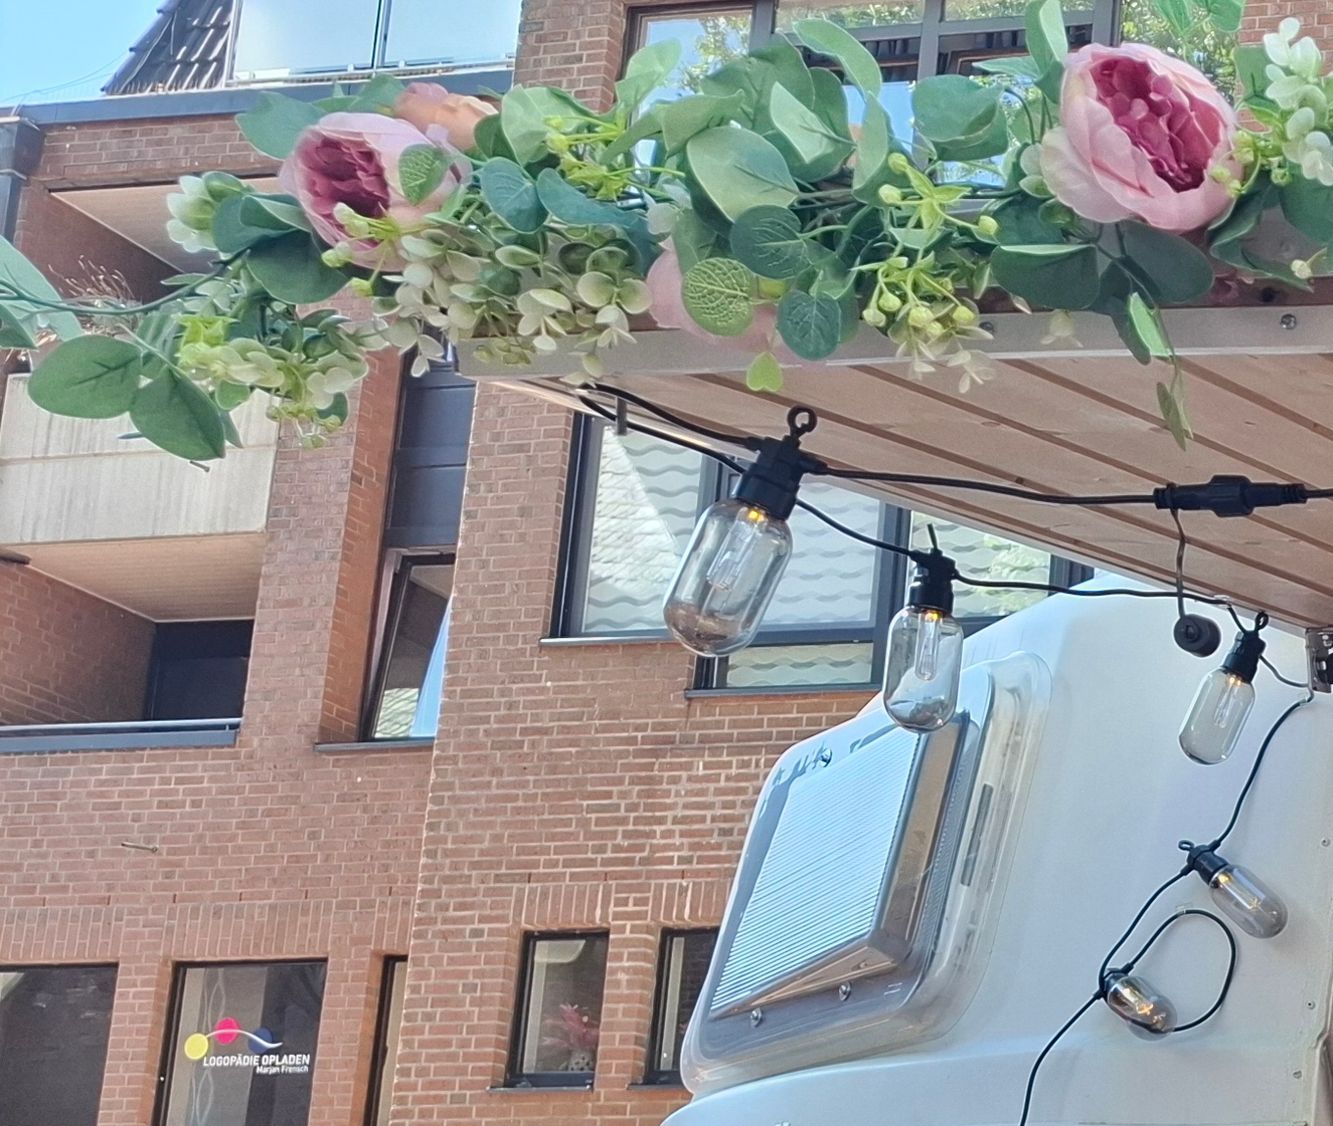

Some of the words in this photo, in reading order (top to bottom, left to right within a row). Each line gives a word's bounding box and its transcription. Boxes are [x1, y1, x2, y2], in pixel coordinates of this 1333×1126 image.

[203, 1054, 259, 1067] LOGOPÄDIE
[261, 1053, 311, 1066] OPLADEN
[281, 1065, 309, 1073] Frensch
